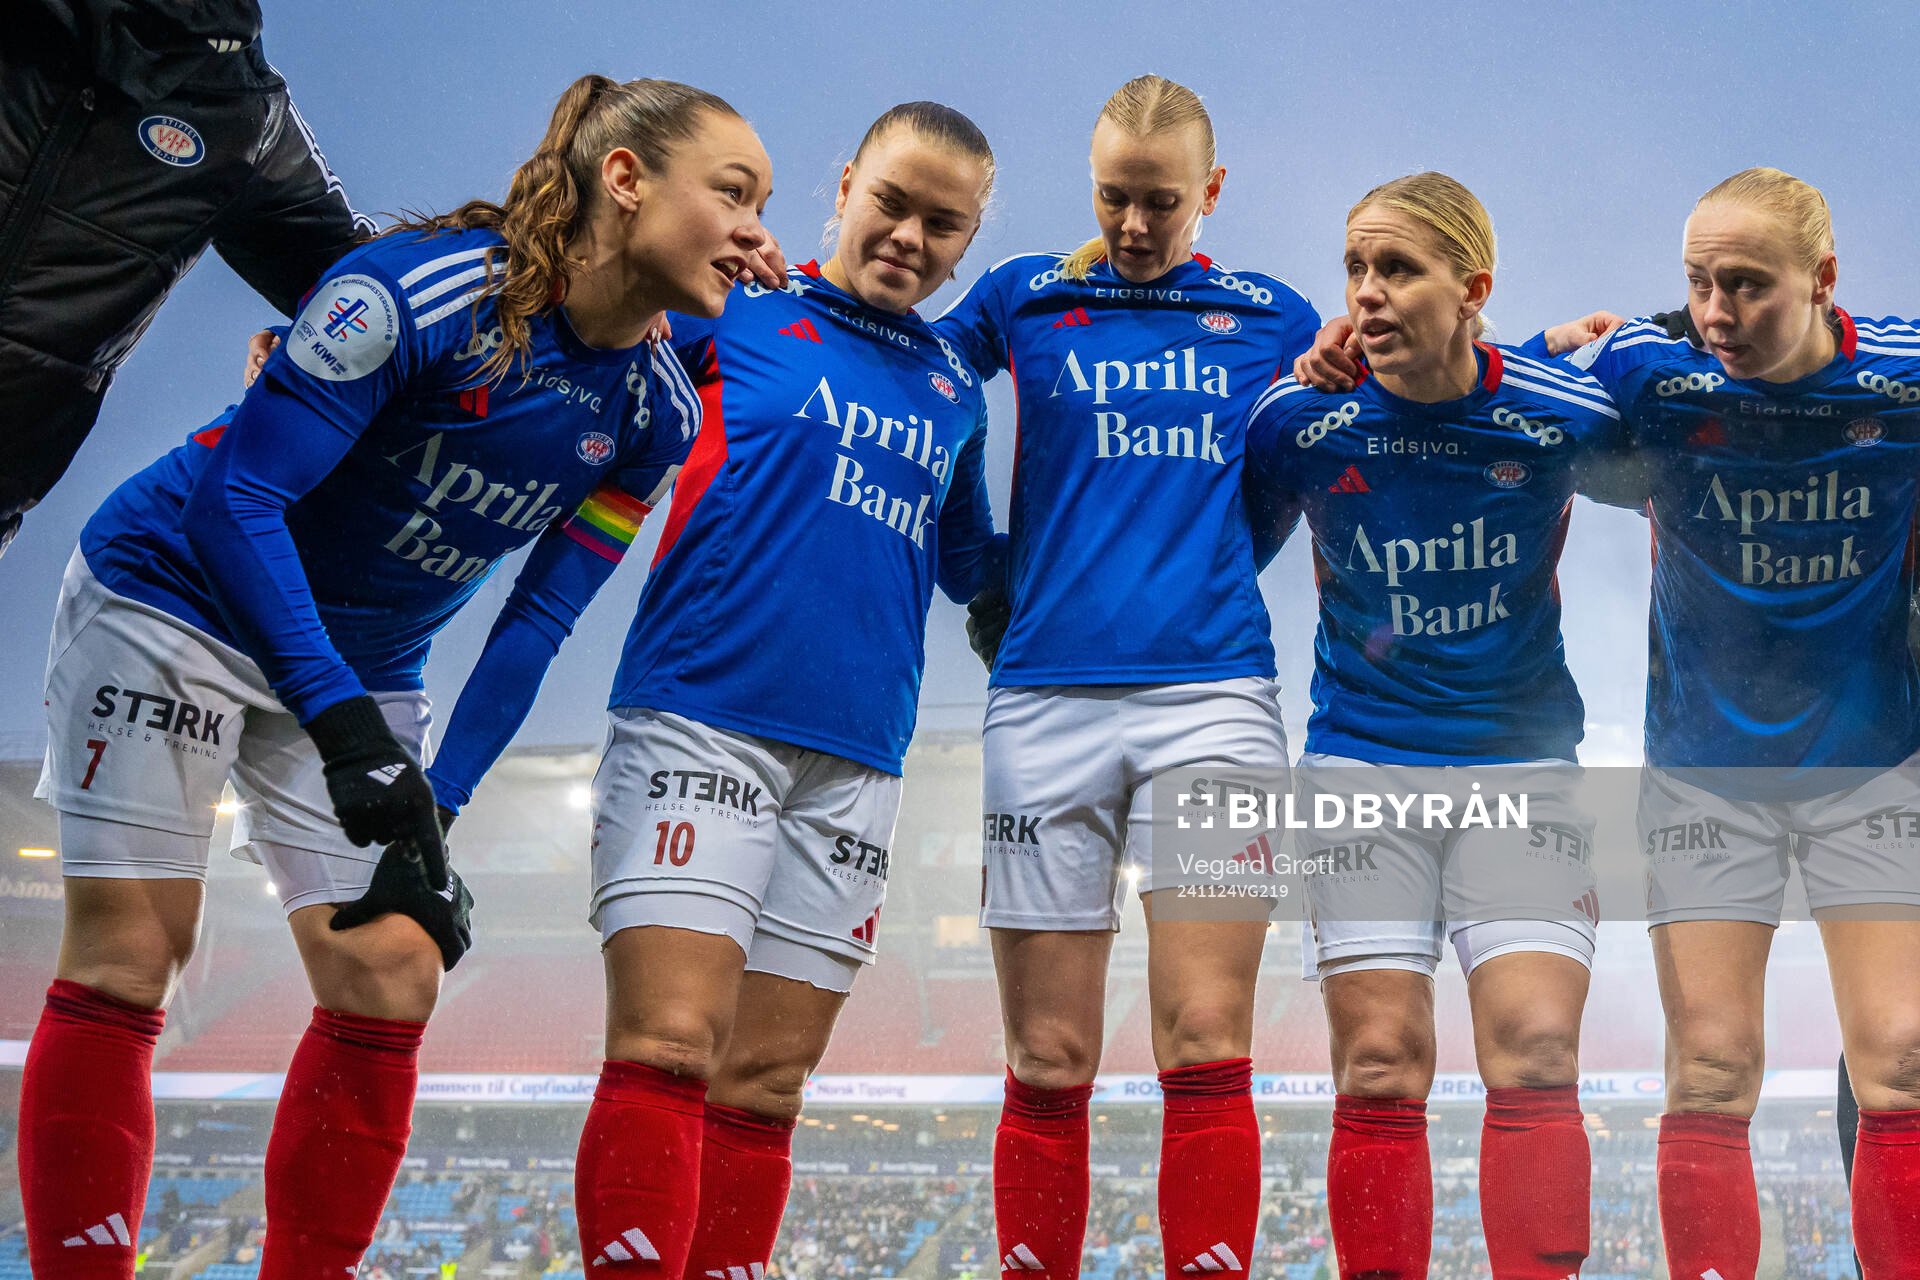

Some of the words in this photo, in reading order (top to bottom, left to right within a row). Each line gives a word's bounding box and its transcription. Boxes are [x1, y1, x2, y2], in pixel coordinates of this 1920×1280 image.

[341, 279, 394, 334] NORGESMESTERSKAPET
[311, 341, 337, 368] KIWI
[1048, 347, 1231, 405] Aprila
[1655, 371, 1726, 397] coop
[792, 376, 950, 486] Aprila
[1093, 411, 1228, 466] Bank
[1296, 401, 1361, 449] coop
[1492, 407, 1564, 447] coop
[383, 431, 563, 531] Aprila
[825, 452, 936, 551] Bank
[1692, 470, 1874, 536] Aprila
[383, 508, 514, 583] Ban
[1345, 516, 1520, 588] Aprila
[1738, 535, 1865, 585] Bank
[1388, 582, 1512, 637] Bank
[81, 738, 107, 790] 7
[87, 722, 134, 738] HELSE
[144, 733, 152, 742] &
[163, 738, 217, 760] TRENING
[645, 802, 684, 811] HELSE
[710, 807, 759, 829] TRENING
[653, 820, 696, 867] 10
[1526, 850, 1561, 863] HELSE
[1682, 853, 1731, 863] TRENING
[824, 865, 858, 883] HELSE
[1330, 874, 1379, 885] TRENING
[817, 1083, 854, 1096] Norsk
[858, 1082, 906, 1098] Tipping
